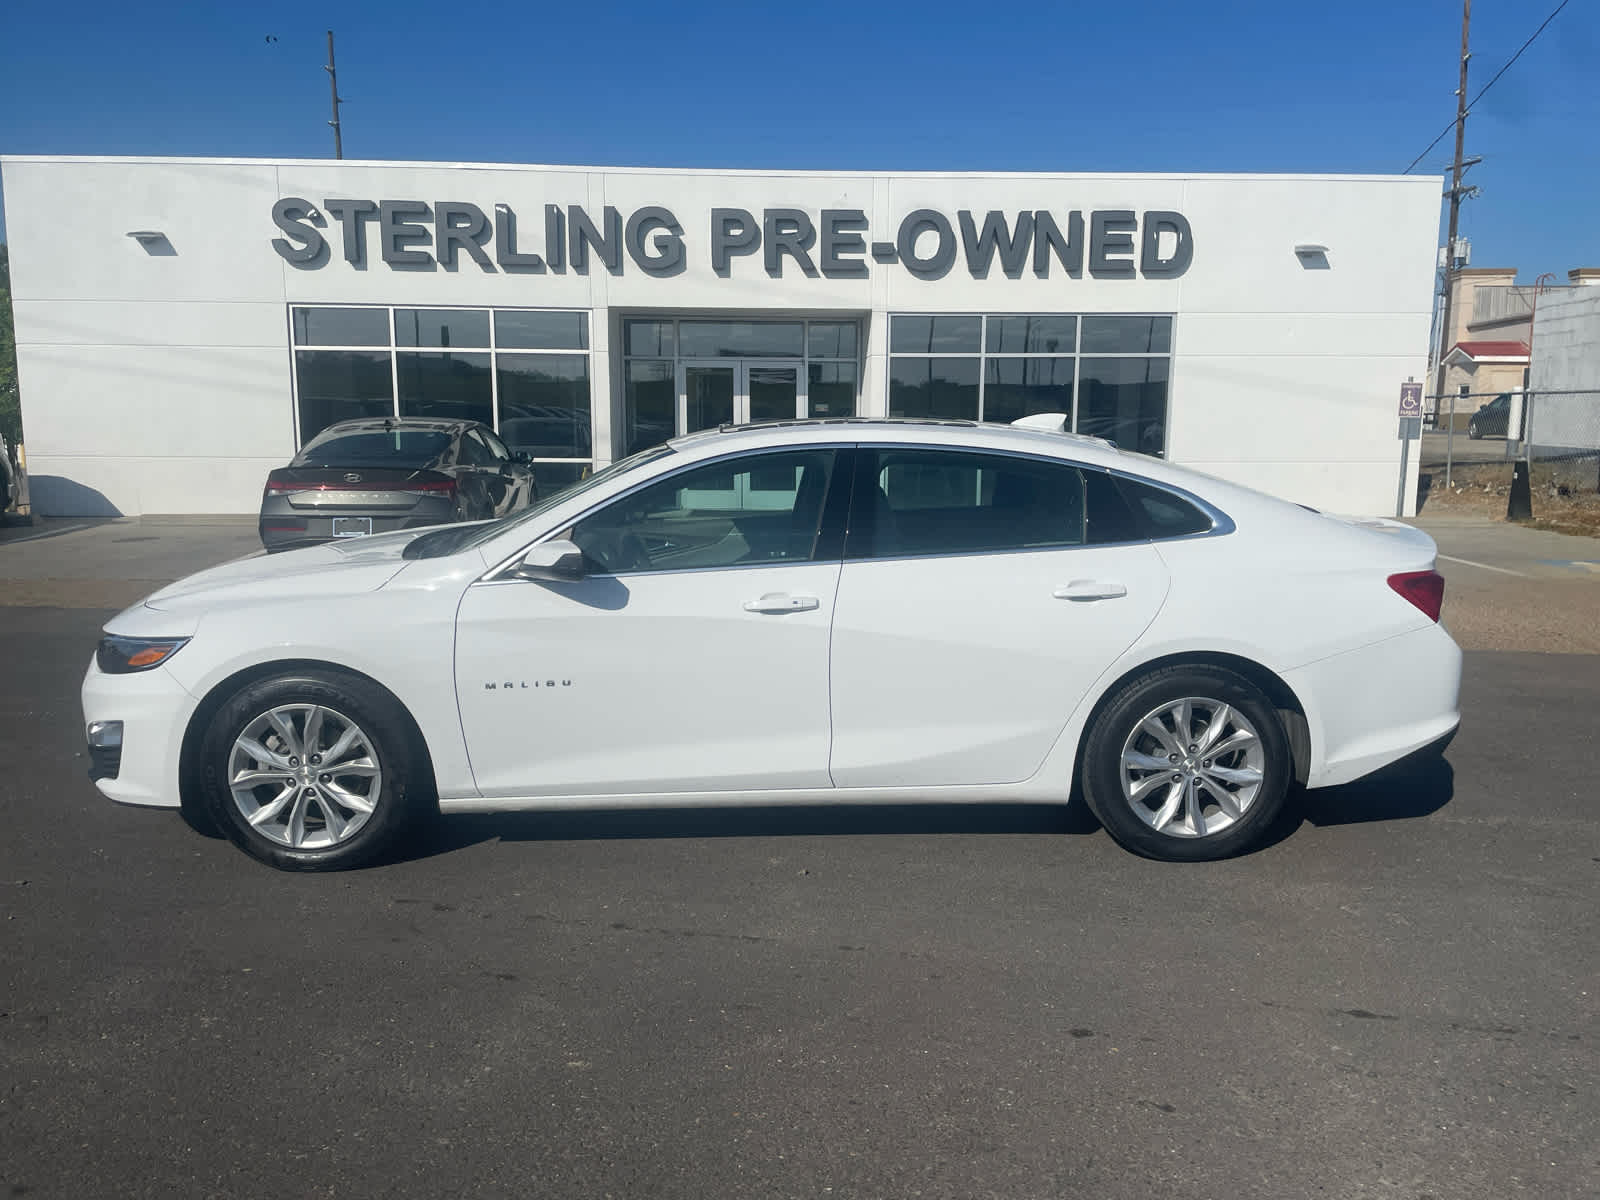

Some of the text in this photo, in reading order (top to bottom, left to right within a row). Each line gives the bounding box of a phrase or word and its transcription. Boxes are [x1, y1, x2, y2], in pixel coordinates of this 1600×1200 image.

[272, 198, 1193, 281] STERLING PRE-OWNED
[485, 679, 572, 690] MALIBU
